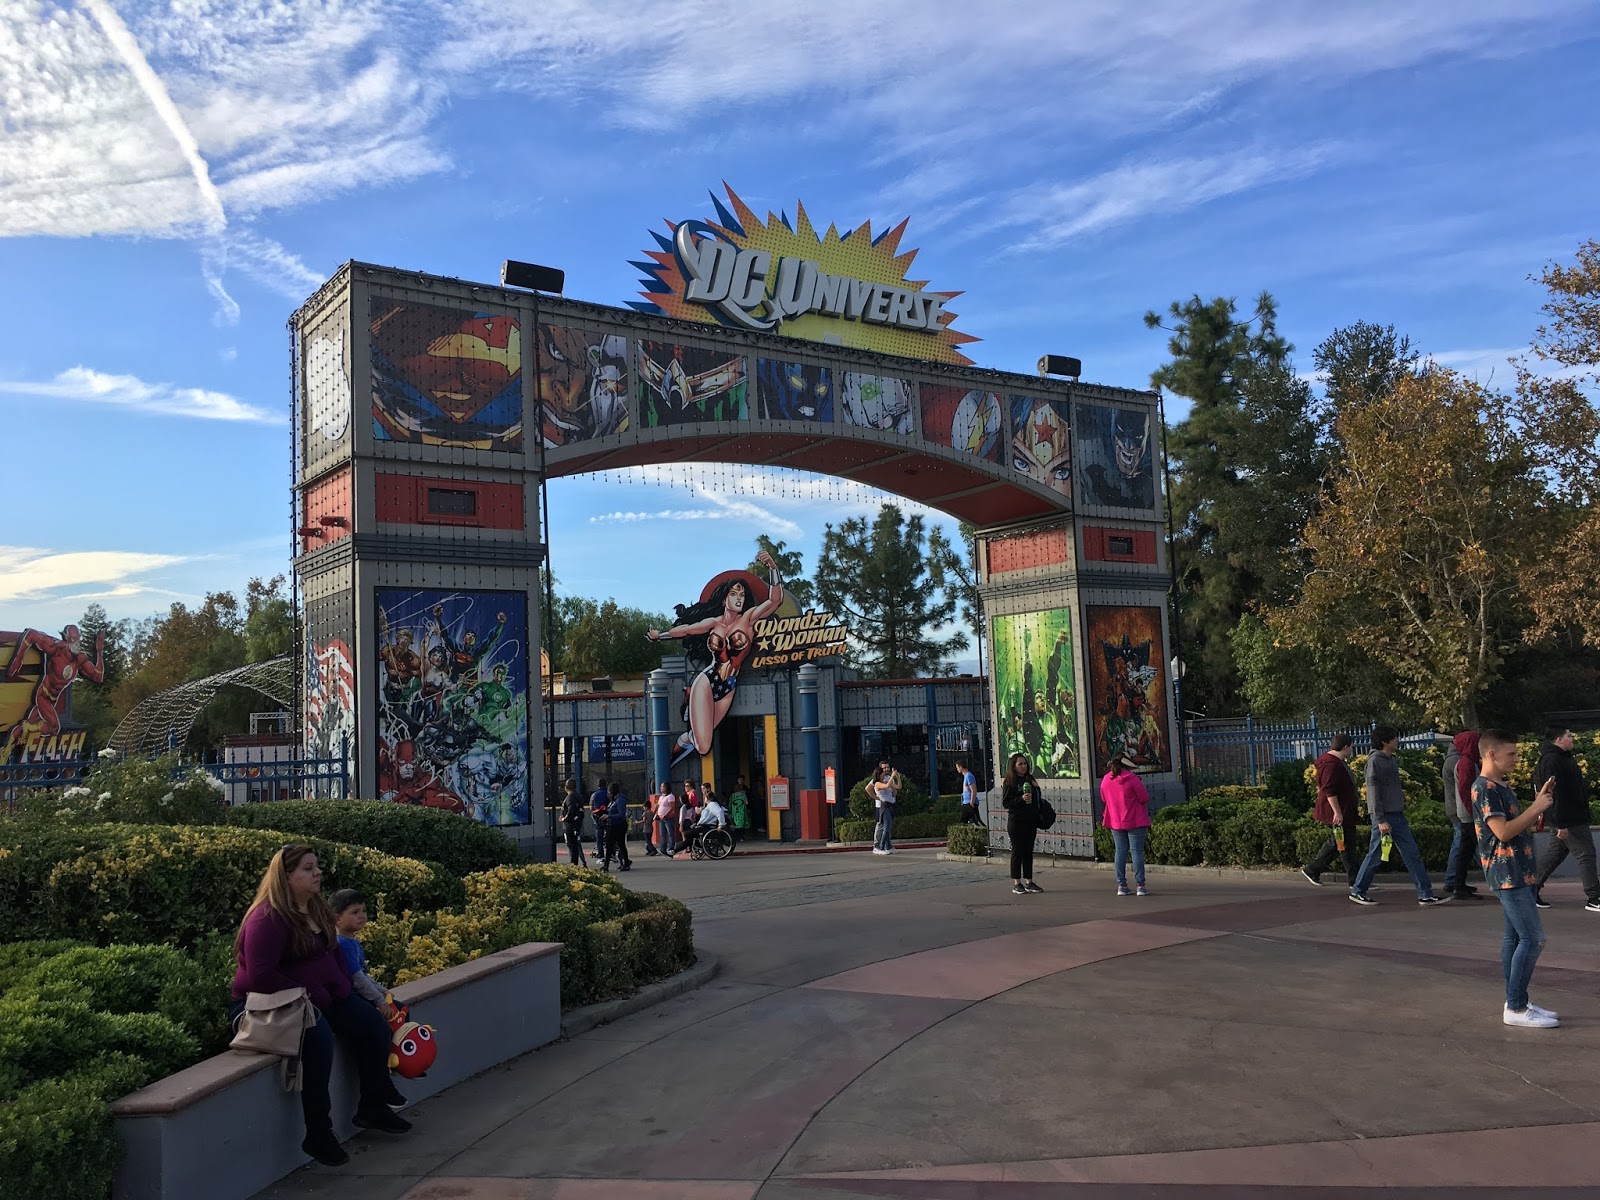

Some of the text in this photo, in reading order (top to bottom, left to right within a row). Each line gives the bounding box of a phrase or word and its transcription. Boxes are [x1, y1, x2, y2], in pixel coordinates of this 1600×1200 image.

[686, 238, 950, 334] DC UNIVERSE
[754, 610, 833, 638] Wonder
[772, 625, 848, 652] Woman
[752, 644, 847, 668] LASSO OF TRUTH
[20, 731, 87, 764] FLASH
